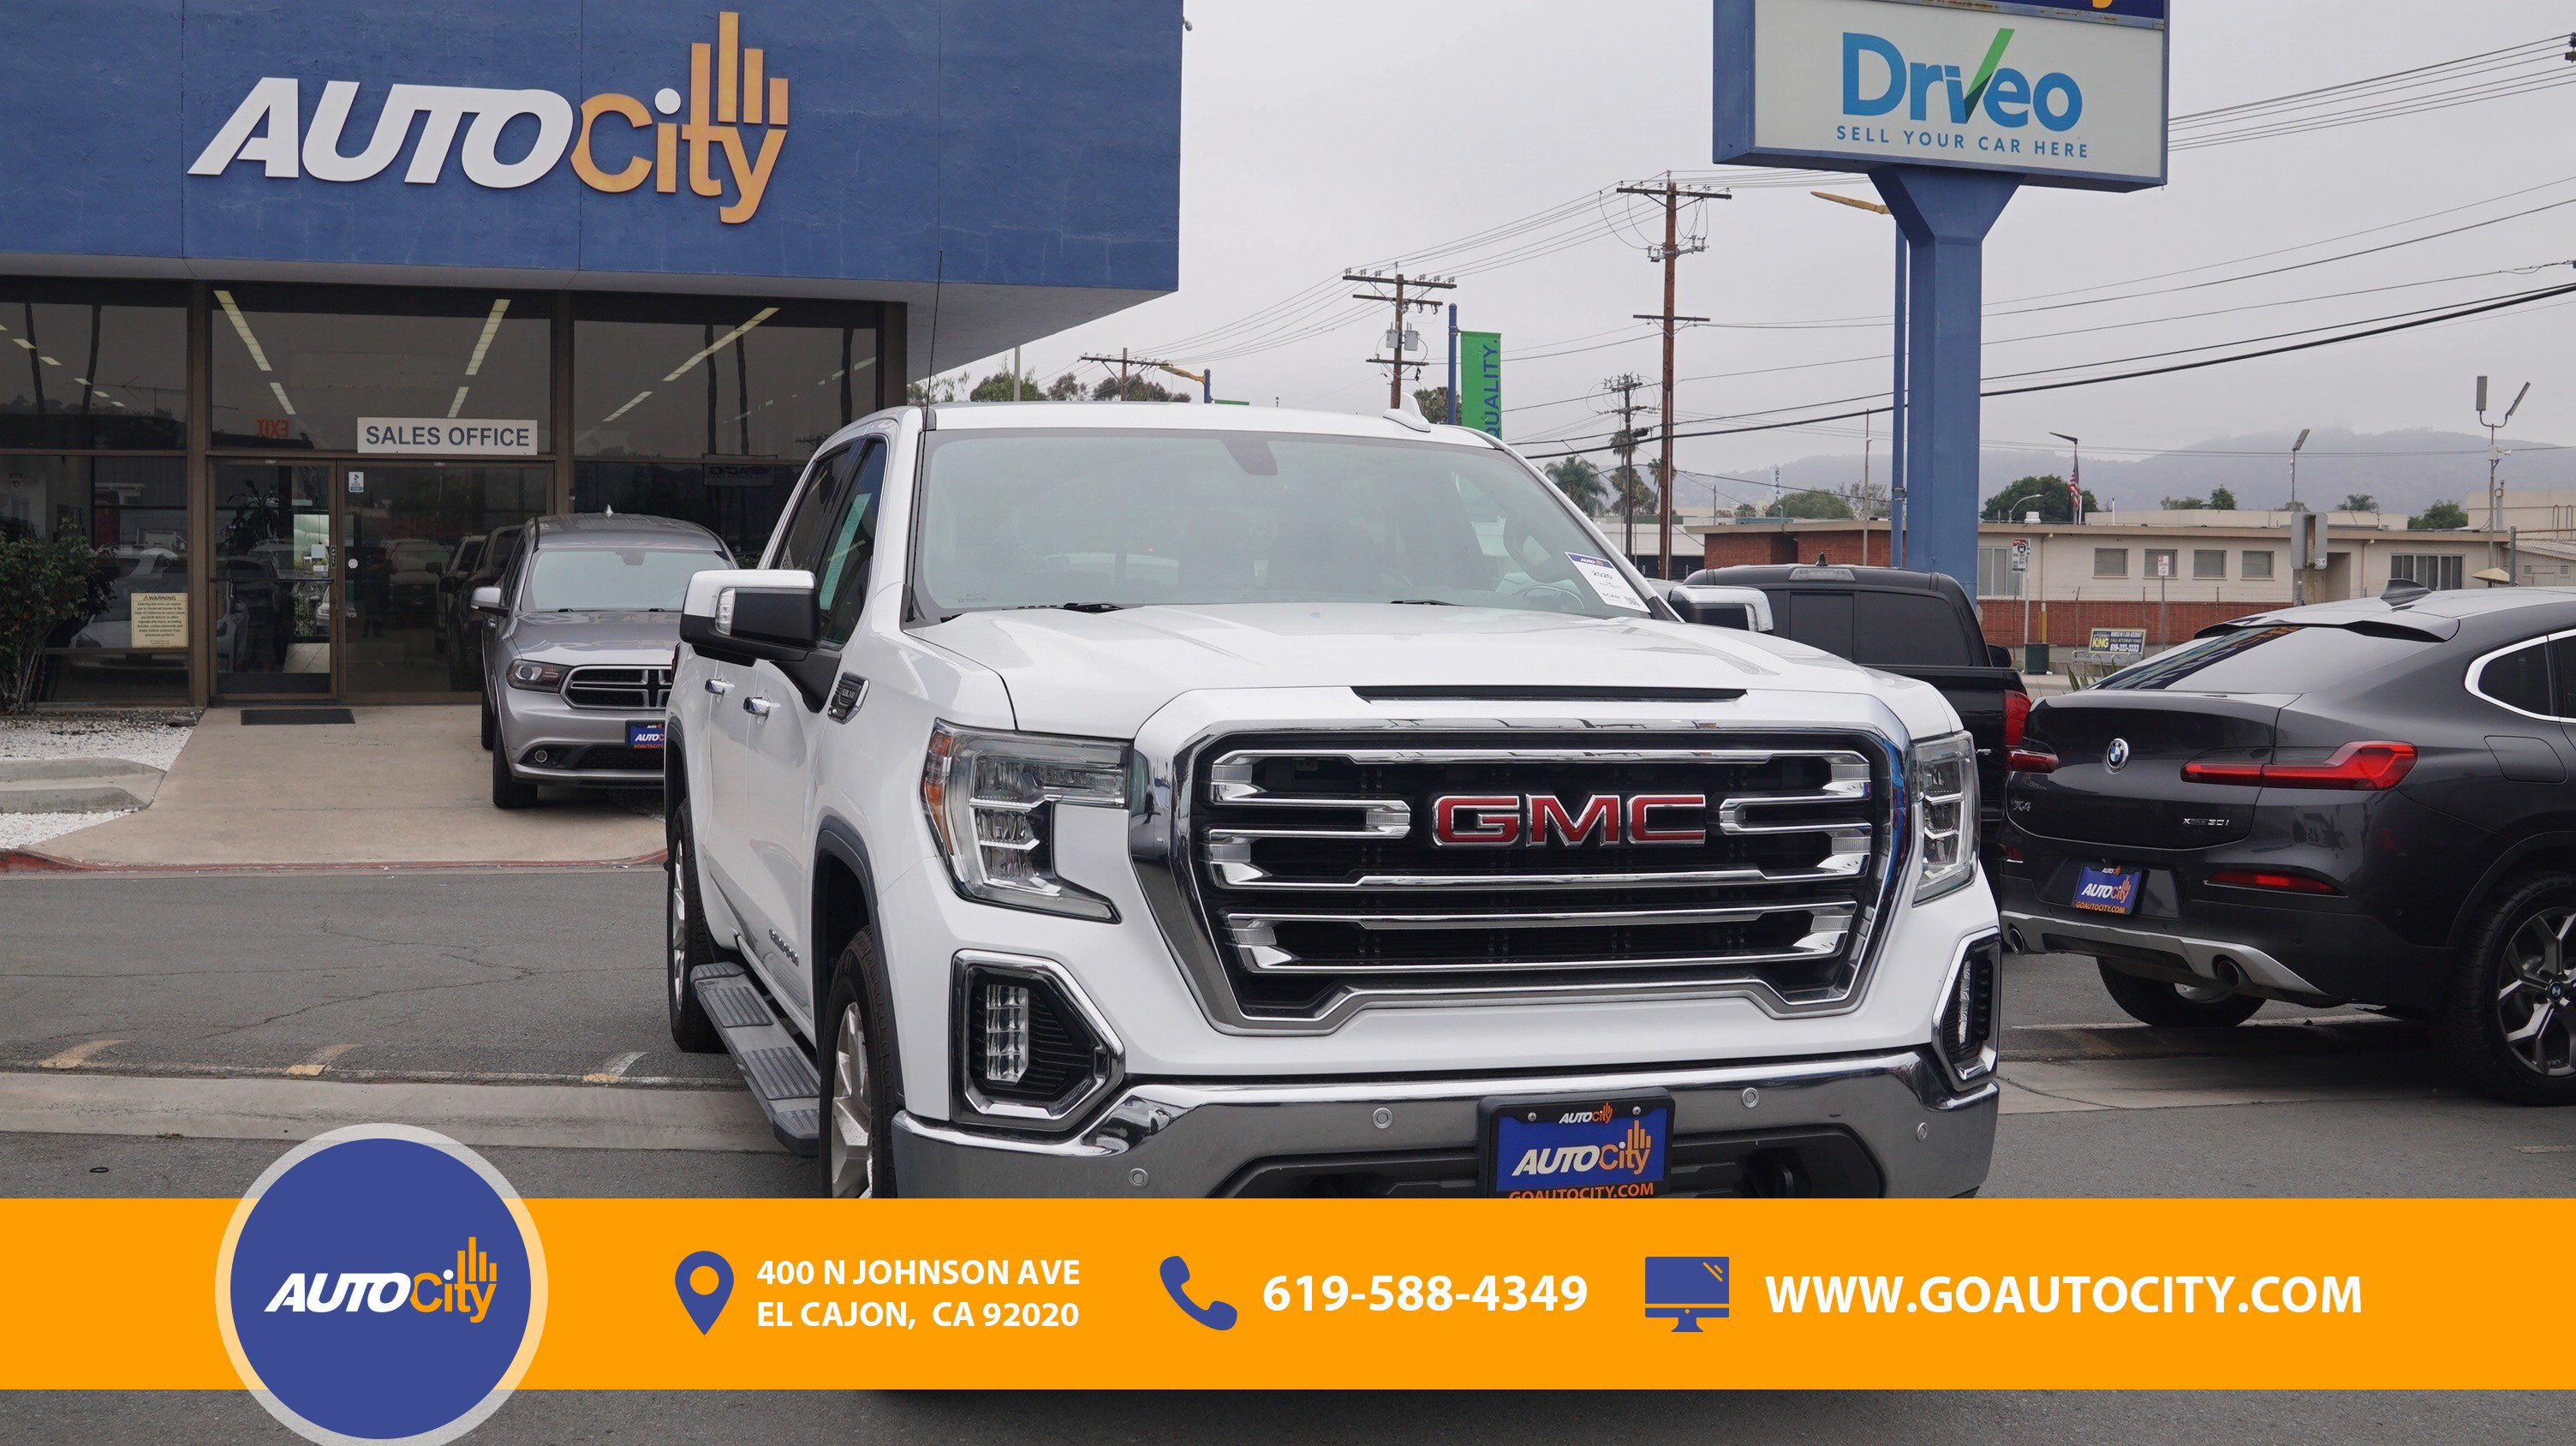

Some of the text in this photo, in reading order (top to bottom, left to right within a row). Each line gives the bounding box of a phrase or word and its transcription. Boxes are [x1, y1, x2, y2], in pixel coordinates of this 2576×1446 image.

[1842, 27, 2083, 132] Driveo
[1837, 125, 2089, 158] SELL YOUR CAR HERE
[366, 426, 529, 447] SALES OFFICE
[2092, 637, 2109, 648] KING
[2109, 643, 2139, 652] 619-333-3333
[635, 733, 665, 742] AUTOC
[2013, 800, 2030, 812] X4
[1431, 793, 1707, 847] GMC
[2076, 901, 2126, 914] GOAUTOCITY.COM
